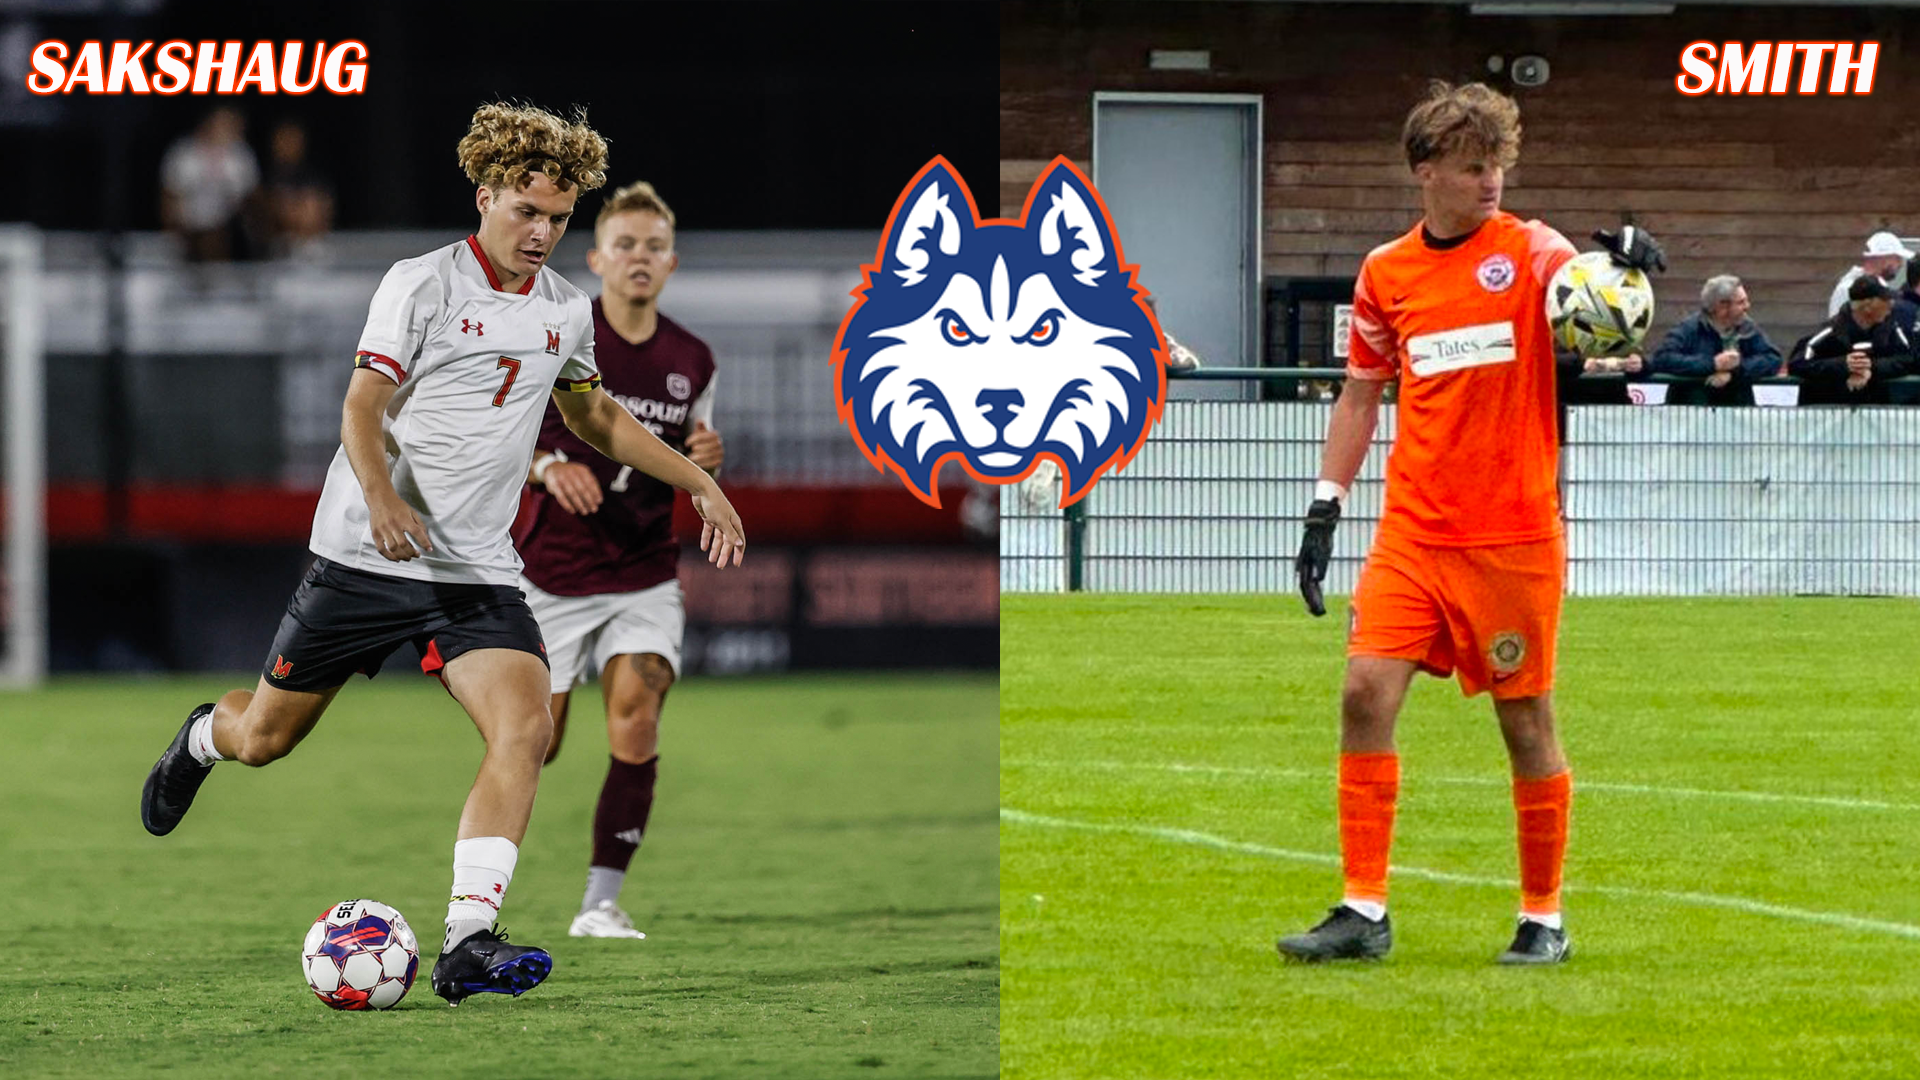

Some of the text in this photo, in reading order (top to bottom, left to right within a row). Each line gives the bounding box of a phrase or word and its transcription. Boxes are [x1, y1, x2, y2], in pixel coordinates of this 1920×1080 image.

[544, 329, 560, 356] M
[492, 355, 521, 408] 7
[271, 654, 294, 679] M
